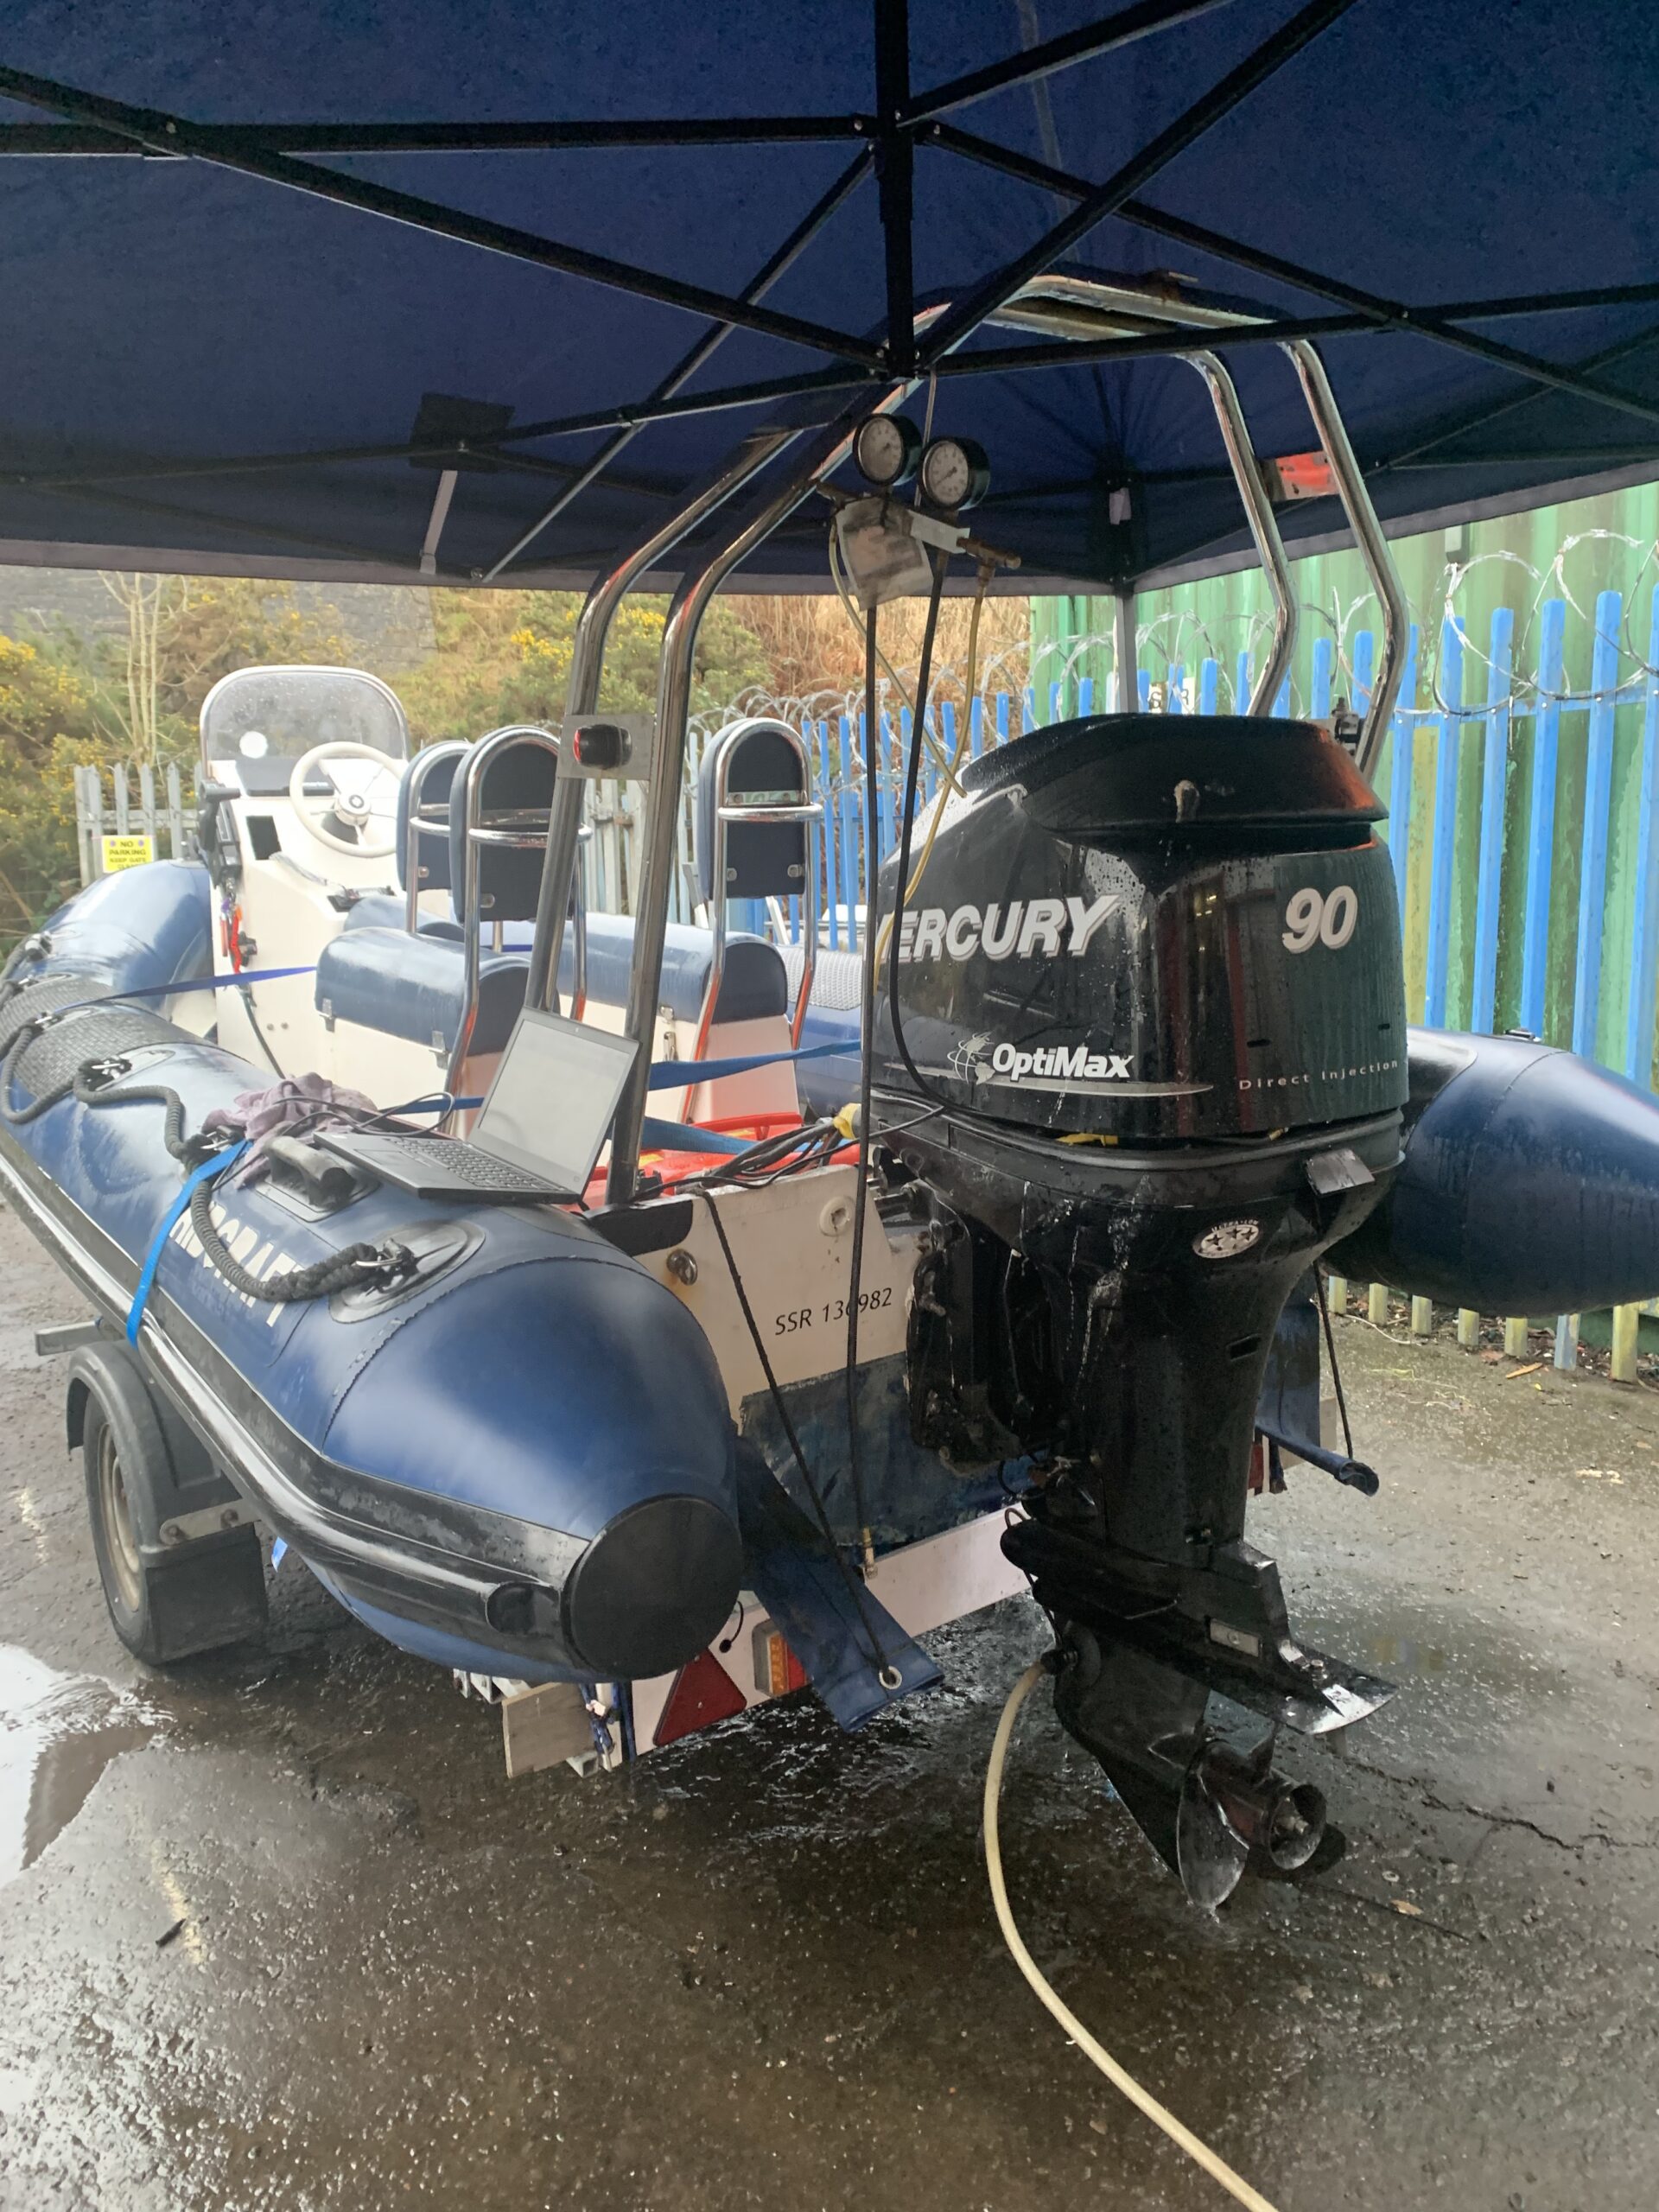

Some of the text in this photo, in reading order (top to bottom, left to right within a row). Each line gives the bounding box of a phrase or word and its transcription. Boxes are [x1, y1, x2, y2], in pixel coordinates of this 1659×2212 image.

[1282, 886, 1358, 954] 90
[993, 1043, 1135, 1081] OptiMax
[1239, 1059, 1397, 1090] Direct Injection
[775, 1308, 812, 1336] SSR
